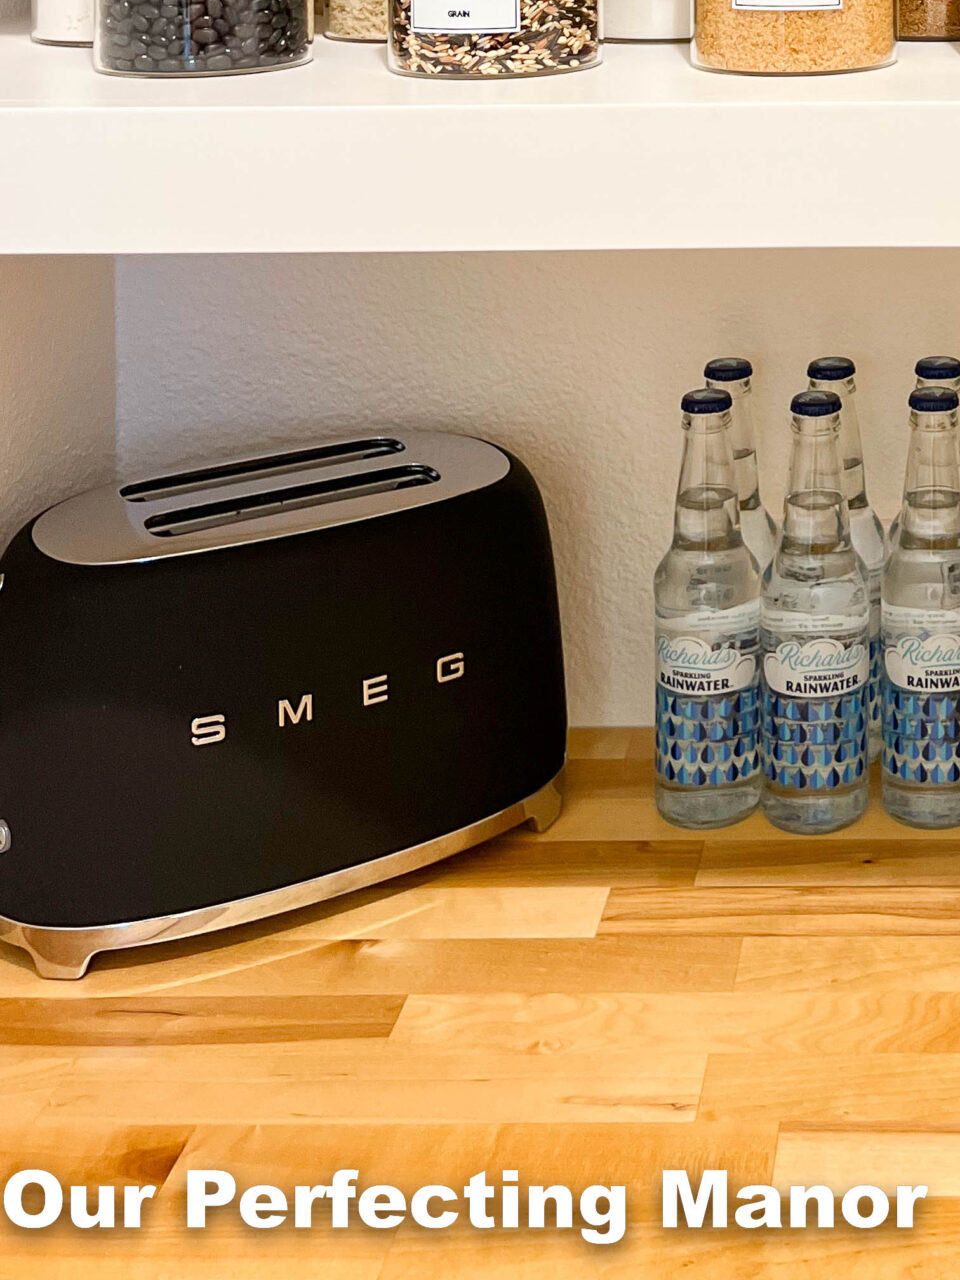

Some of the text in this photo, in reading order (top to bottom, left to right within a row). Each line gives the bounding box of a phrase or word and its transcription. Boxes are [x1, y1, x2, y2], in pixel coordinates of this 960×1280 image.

[672, 669, 711, 679] SPARKLING
[803, 671, 844, 682] SPARKLING
[660, 672, 730, 692] RAINWATER
[785, 674, 859, 694] RAINWATER
